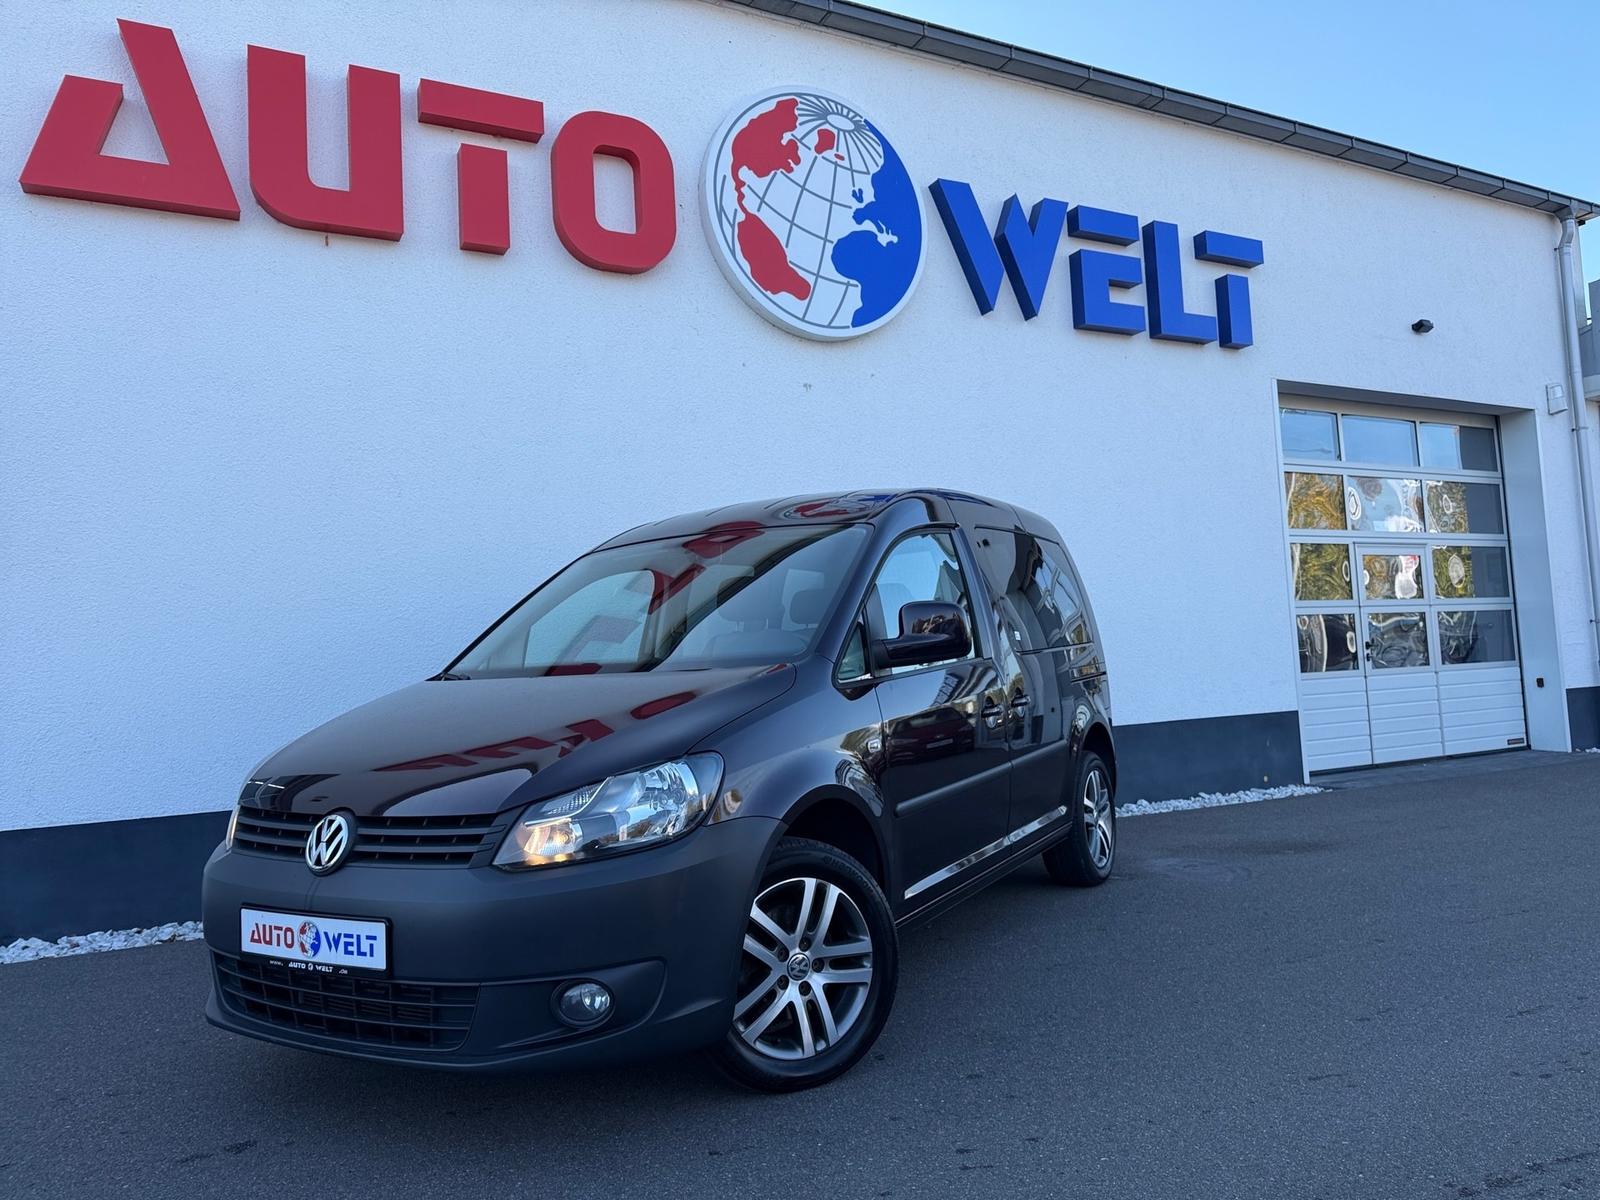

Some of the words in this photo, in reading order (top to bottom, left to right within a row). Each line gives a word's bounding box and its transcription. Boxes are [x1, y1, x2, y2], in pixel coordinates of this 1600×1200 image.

[20, 18, 677, 274] AUTO
[928, 178, 1264, 350] WELT
[250, 923, 294, 949] AUTO
[323, 931, 377, 957] WELT
[288, 961, 306, 969] AUTO
[315, 964, 333, 973] WELT
